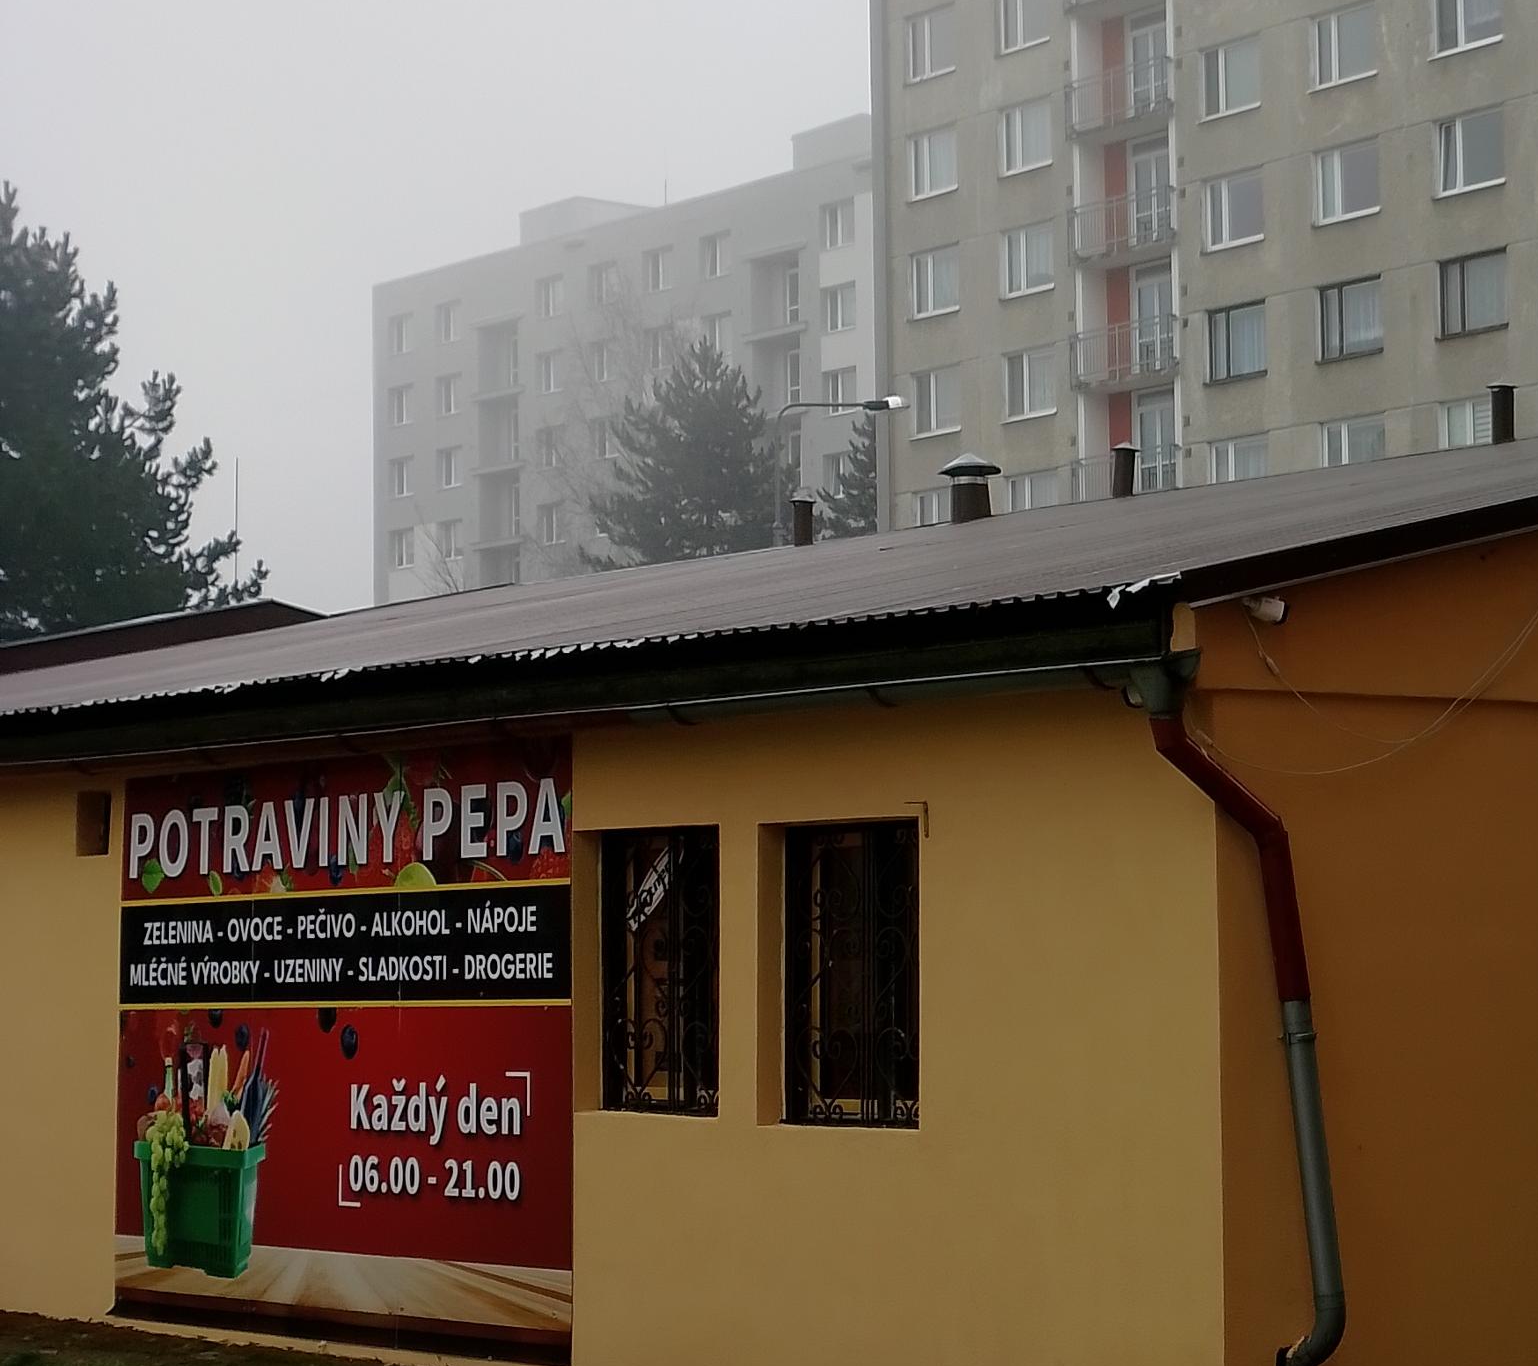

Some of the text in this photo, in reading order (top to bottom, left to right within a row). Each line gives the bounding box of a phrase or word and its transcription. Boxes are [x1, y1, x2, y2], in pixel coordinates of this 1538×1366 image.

[129, 777, 566, 880] POTRAVINY PEPA
[142, 920, 213, 946] ZELENINA
[227, 916, 283, 944] OVOCE
[297, 908, 356, 940] PEČIVO
[371, 909, 450, 937] ALKOHOL
[467, 901, 538, 934] NÁPOJE
[129, 954, 188, 987] MLÉČNÉ
[191, 954, 261, 985] VÝROBKY
[274, 958, 343, 984] UZENINY
[358, 955, 447, 982] SLADKOSTI
[464, 952, 553, 981] DROGERIE
[349, 1074, 522, 1146] Každý den
[348, 1154, 420, 1195] 06.00
[443, 1157, 521, 1201] 21.00
